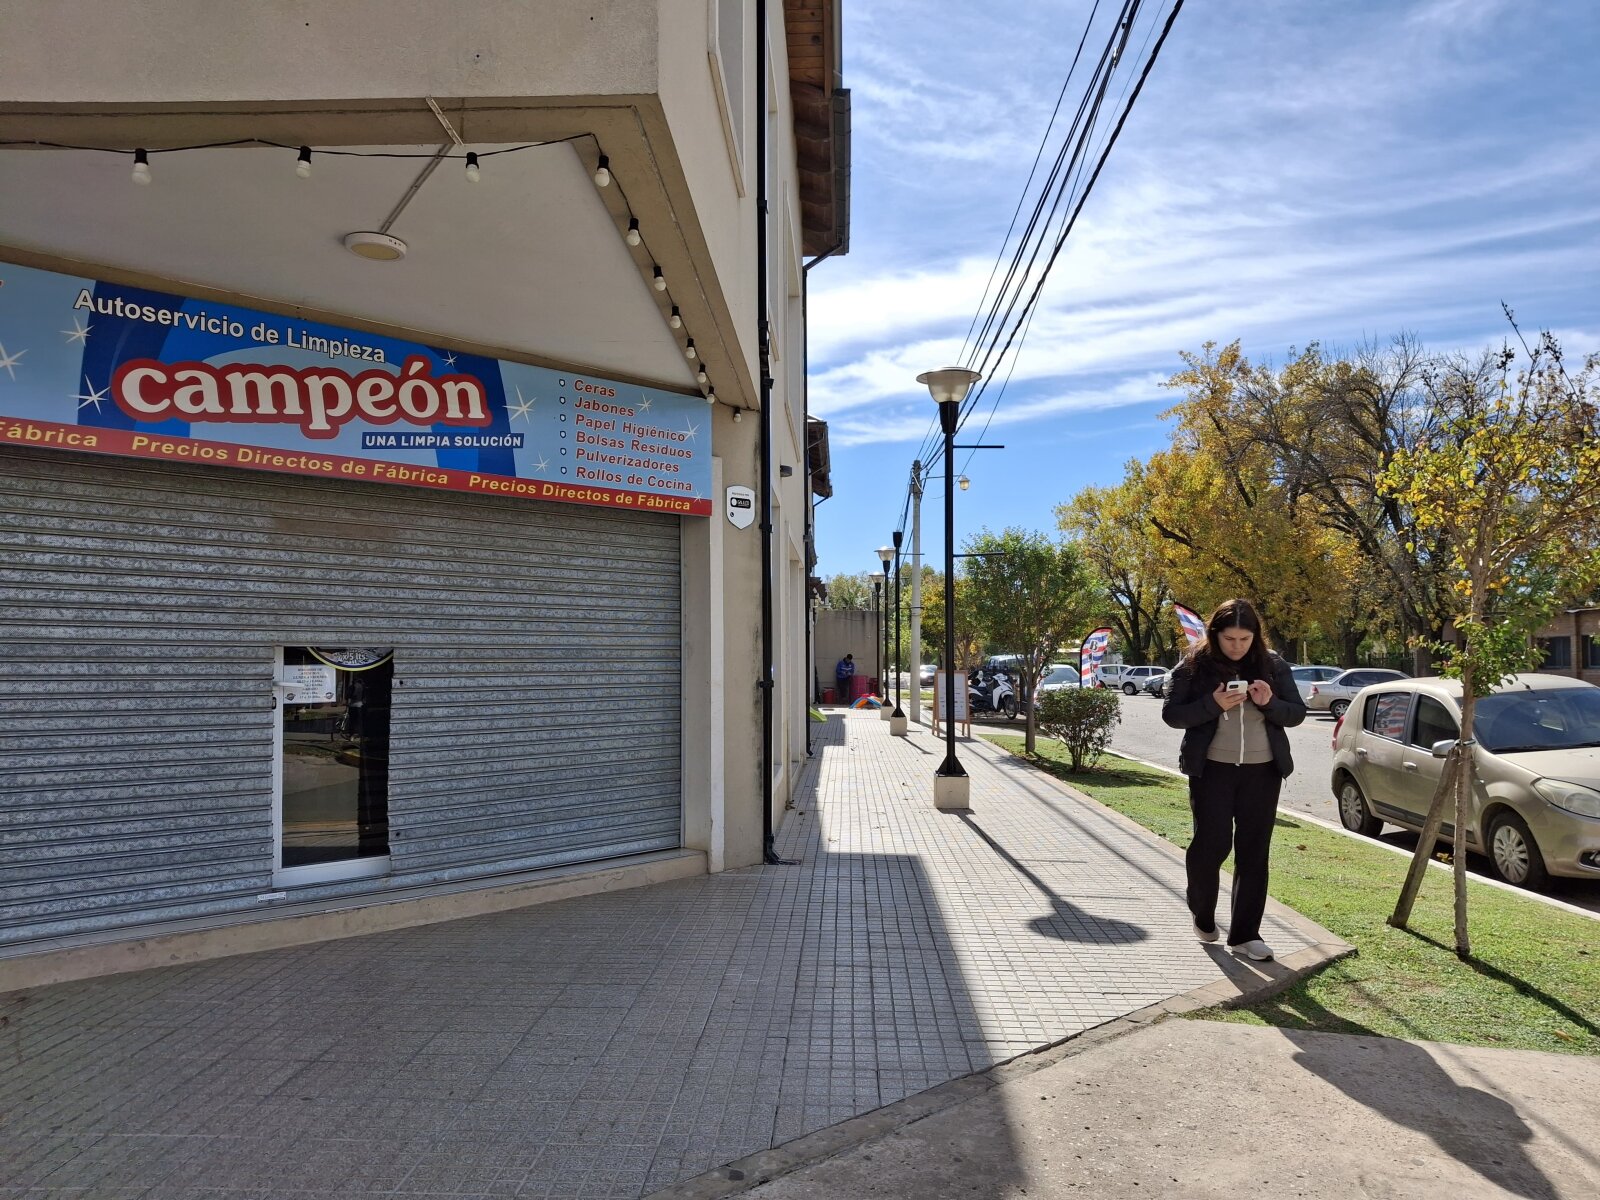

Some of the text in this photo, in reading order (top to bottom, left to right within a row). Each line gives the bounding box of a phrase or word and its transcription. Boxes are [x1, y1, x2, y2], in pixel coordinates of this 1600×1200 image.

[73, 289, 385, 363] Autoservicio de Limpieza
[121, 361, 486, 430] campeón
[574, 379, 616, 398] Ceras
[575, 397, 635, 417] Jabones
[365, 433, 522, 447] UNA LIMPIA SOLUCIÓN
[575, 414, 686, 442] Papel Higiénico
[576, 431, 693, 459] Bolsas Residuos
[132, 436, 448, 485] Precios Directos de Fábrica
[576, 449, 680, 473] Pulverizadores
[469, 475, 690, 511] Precios Directos de Fábrica
[576, 467, 693, 491] Rollos de Cocina
